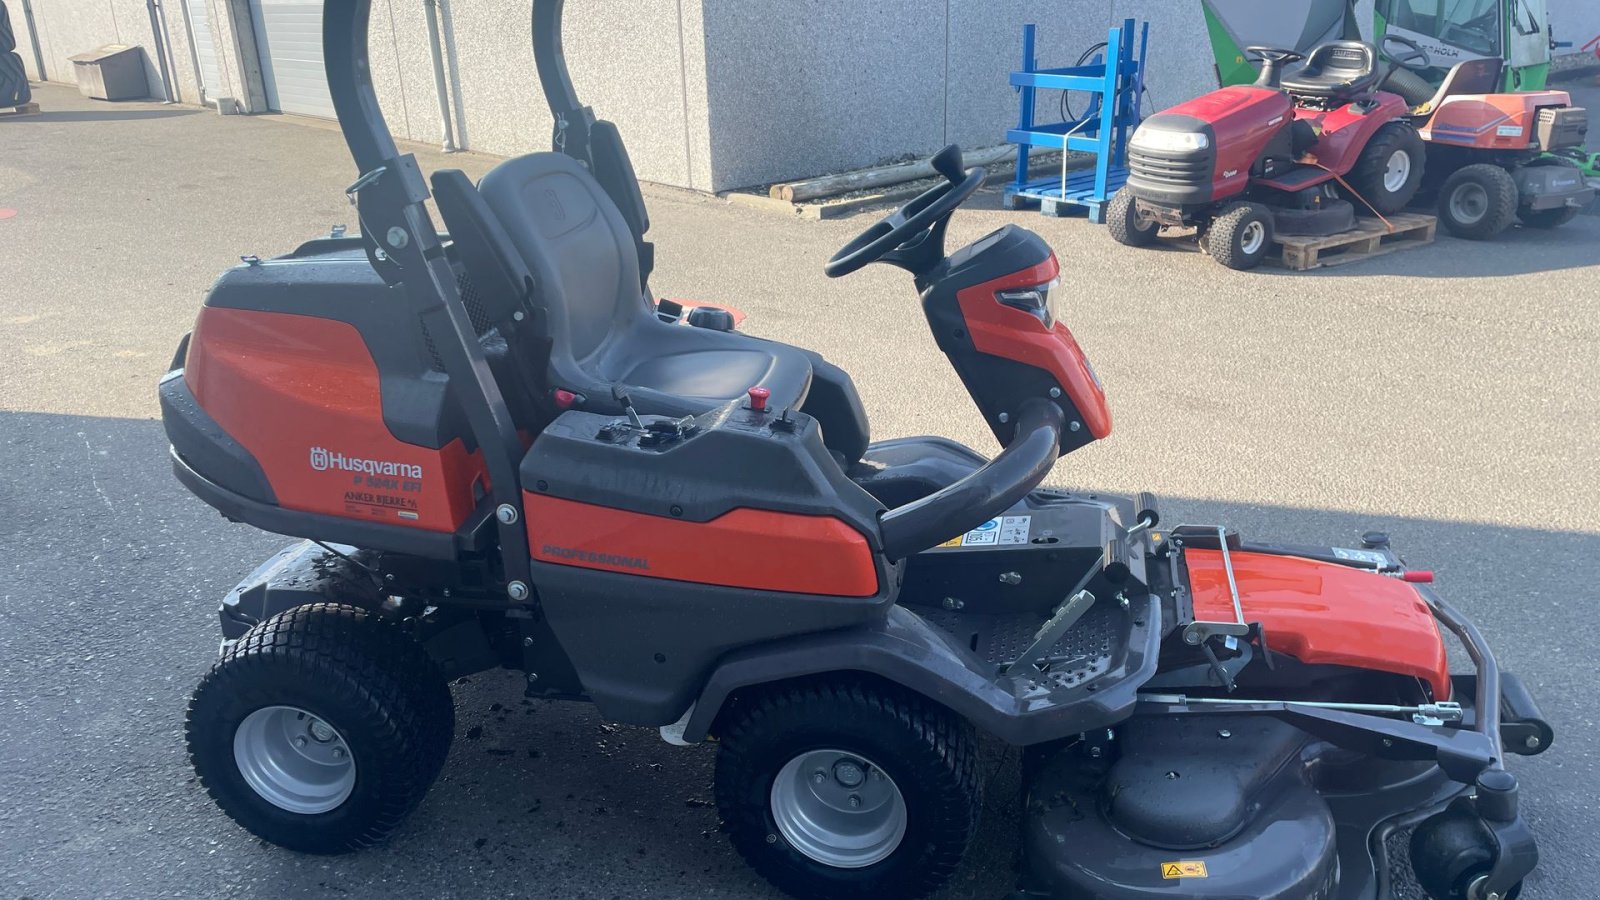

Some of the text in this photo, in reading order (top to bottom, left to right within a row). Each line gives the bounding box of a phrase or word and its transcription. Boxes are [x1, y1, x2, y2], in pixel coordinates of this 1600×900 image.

[329, 452, 422, 479] Husqvarna
[344, 491, 375, 503] ANKER
[542, 544, 650, 570] PROFESSIONAL
